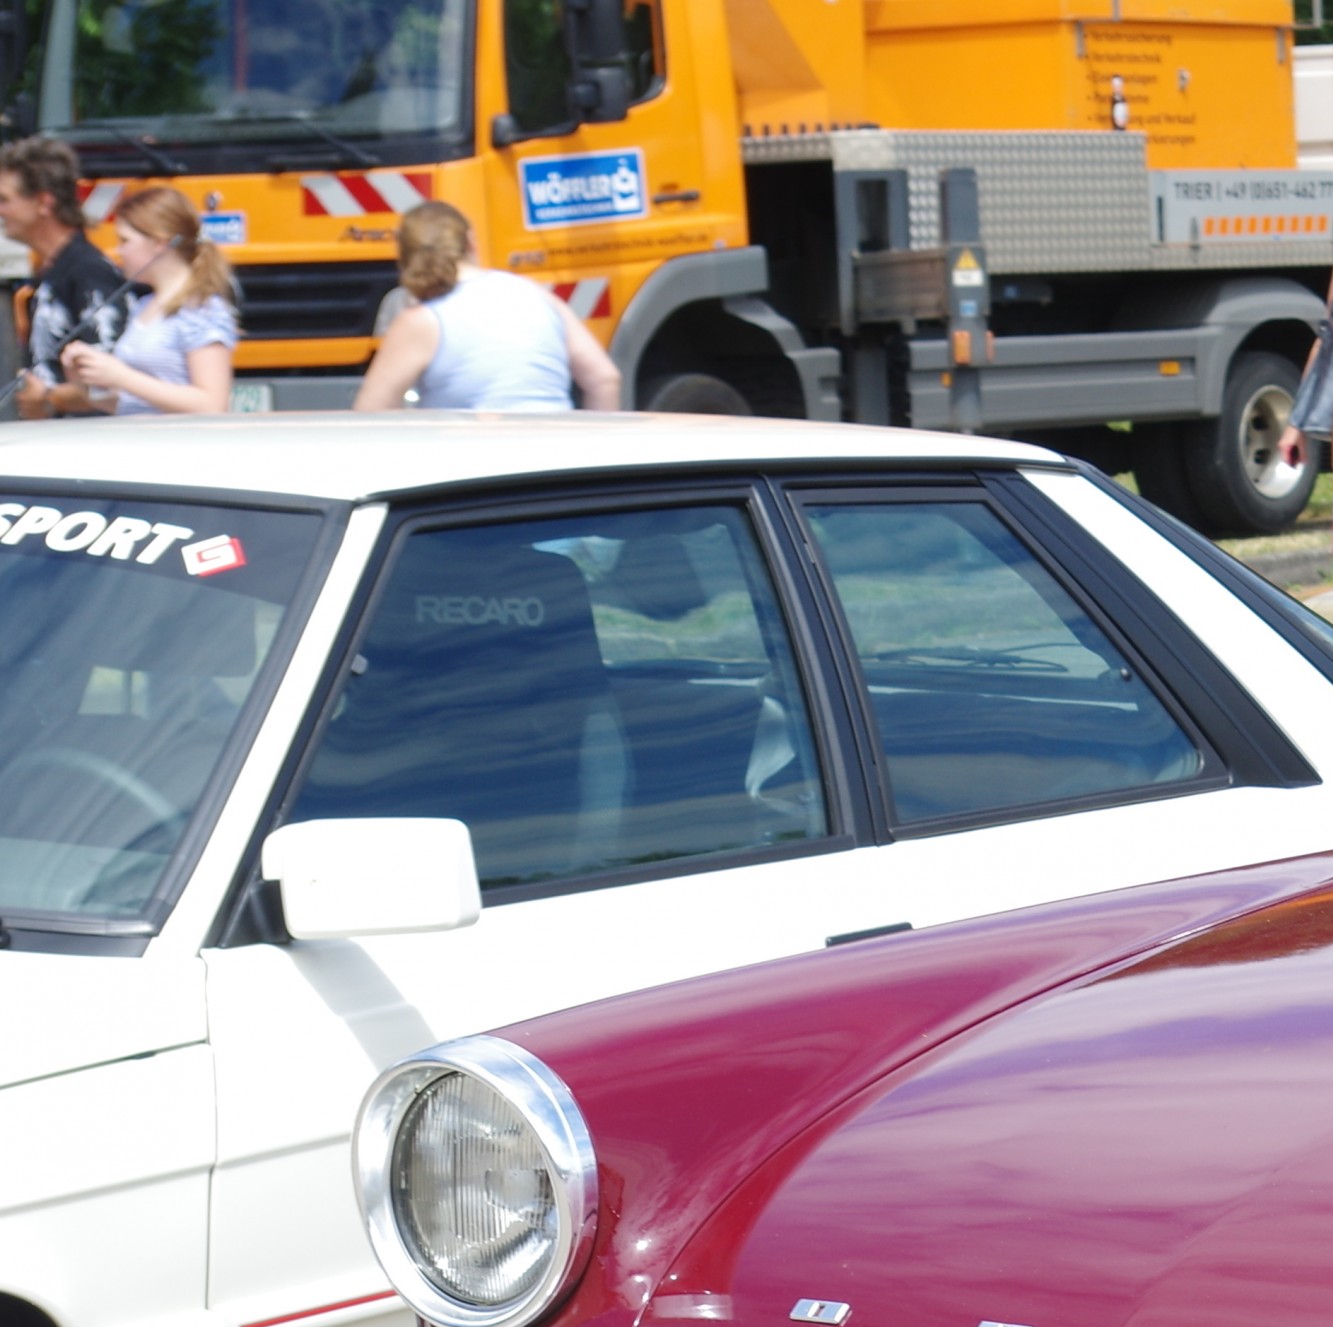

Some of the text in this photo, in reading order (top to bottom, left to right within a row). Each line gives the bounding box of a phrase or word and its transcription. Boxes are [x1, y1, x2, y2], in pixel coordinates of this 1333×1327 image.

[527, 171, 612, 206] WÖFFLER
[1174, 181, 1212, 200] TRIER
[0, 502, 194, 565] SPORT
[416, 595, 544, 627] RECARO
